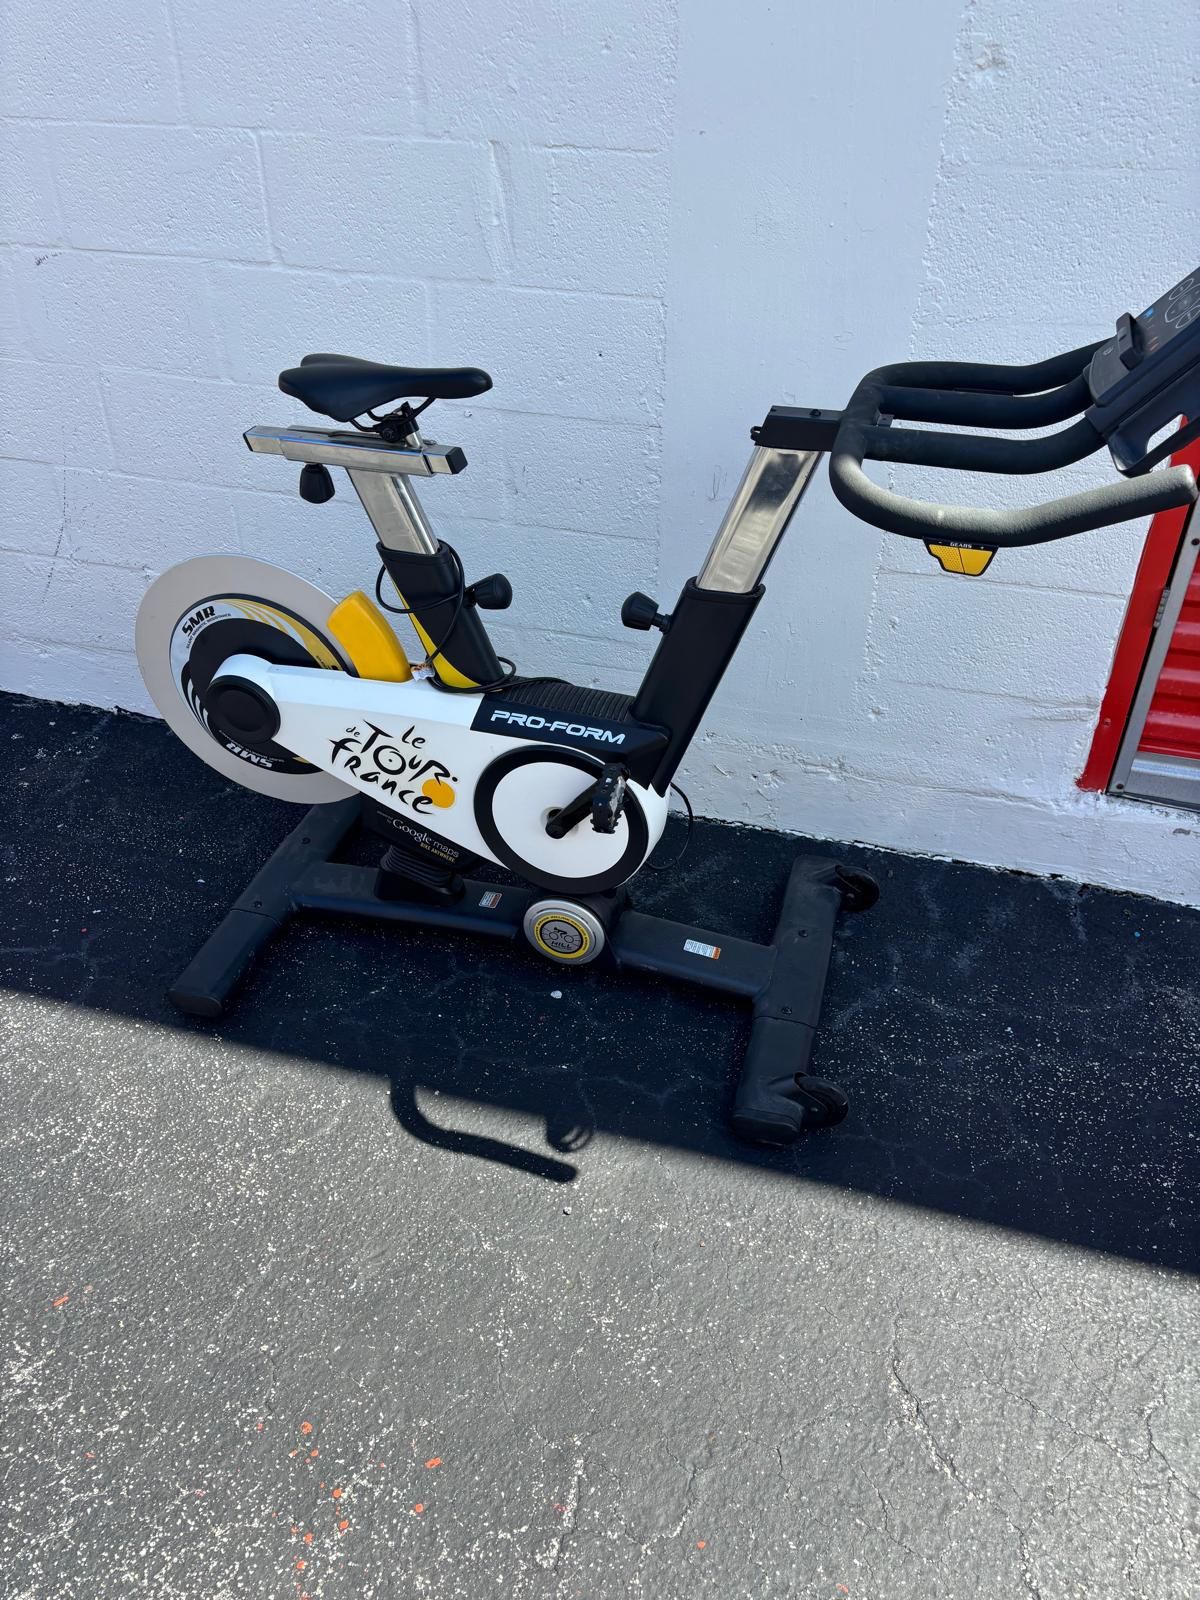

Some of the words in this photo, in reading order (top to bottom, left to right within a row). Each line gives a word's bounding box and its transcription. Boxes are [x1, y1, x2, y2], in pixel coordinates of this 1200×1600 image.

[181, 605, 216, 637] SMR
[490, 709, 626, 745] PRO-FORM
[226, 742, 273, 768] SMR
[392, 818, 432, 844] Google
[431, 839, 460, 858] maps
[551, 940, 572, 950] HILL
